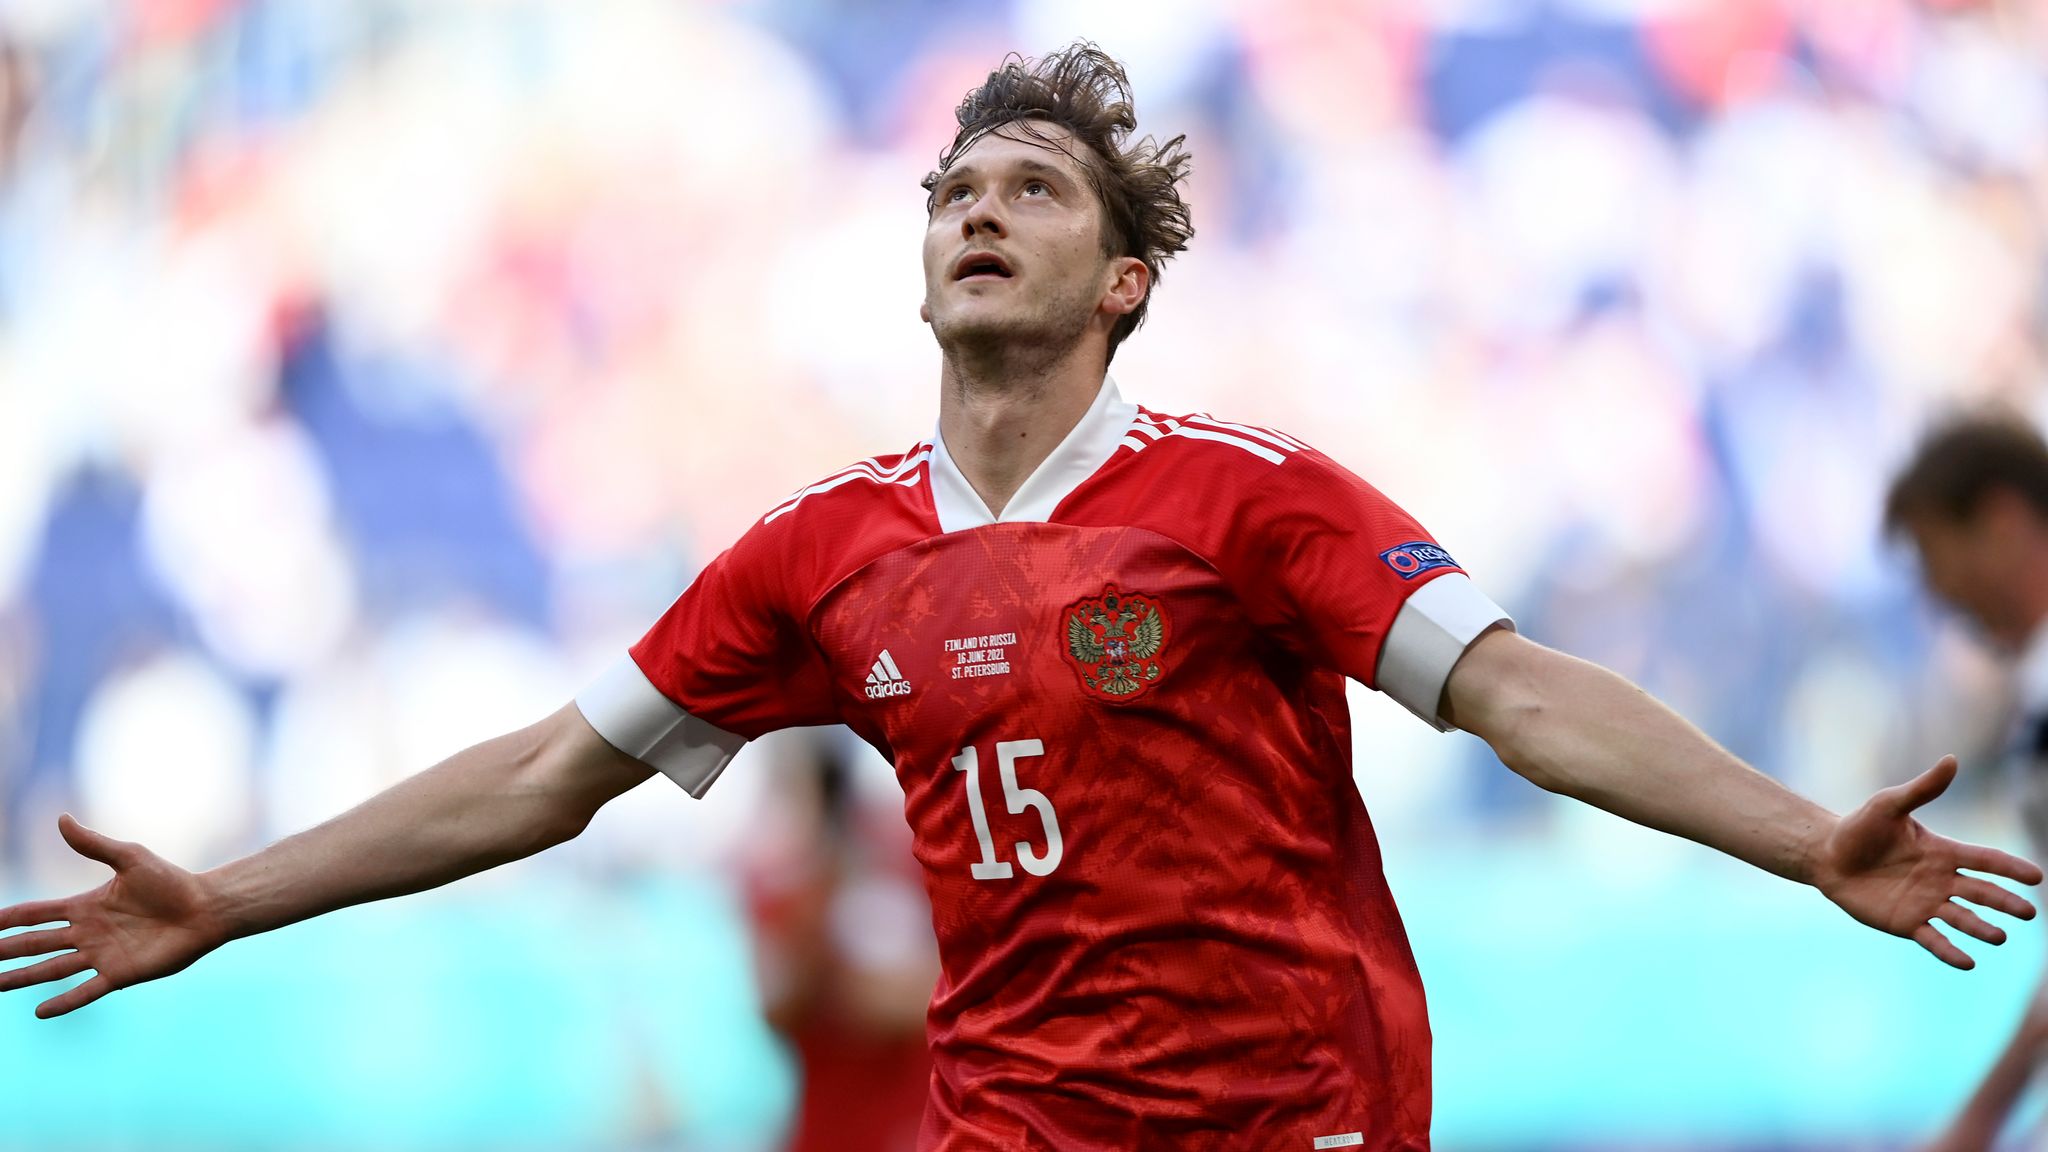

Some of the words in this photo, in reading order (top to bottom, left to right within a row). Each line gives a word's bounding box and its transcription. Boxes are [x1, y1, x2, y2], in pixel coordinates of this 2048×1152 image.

[945, 639, 977, 652] FINLAND
[979, 636, 988, 648] VS
[990, 633, 1016, 646] RUSSIA
[957, 653, 966, 664] 16
[967, 650, 985, 663] JUNE
[987, 649, 1004, 661] 2021
[951, 668, 963, 679] ST.
[964, 662, 1010, 678] PETERSBURG
[865, 680, 911, 699] adidas
[951, 738, 1064, 880] 15
